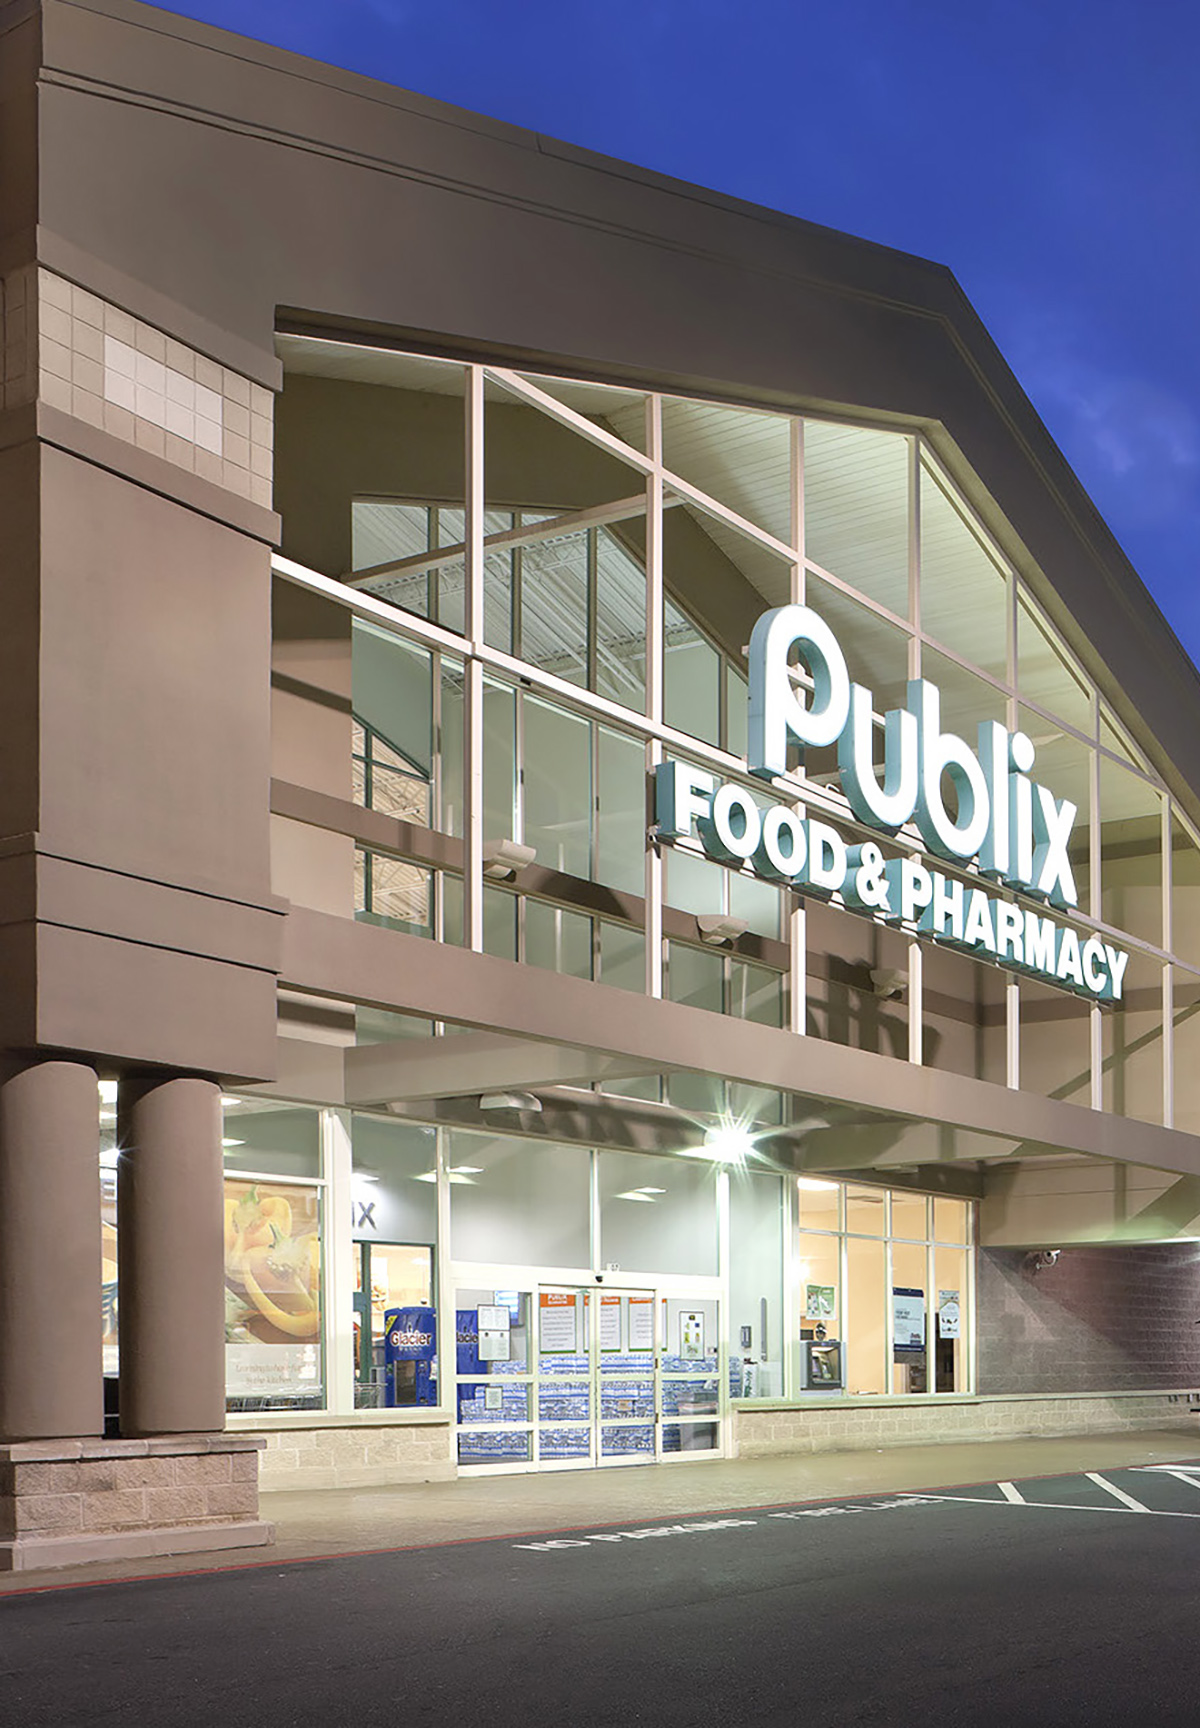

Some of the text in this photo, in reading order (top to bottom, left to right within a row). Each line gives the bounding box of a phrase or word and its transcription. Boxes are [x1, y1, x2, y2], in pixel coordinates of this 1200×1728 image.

[748, 604, 1078, 909] Publix
[657, 761, 1129, 1001] FOOD & PHARMACY
[391, 1332, 432, 1346] Glacier
[511, 1539, 591, 1552] NO
[584, 1519, 758, 1542] PARKING
